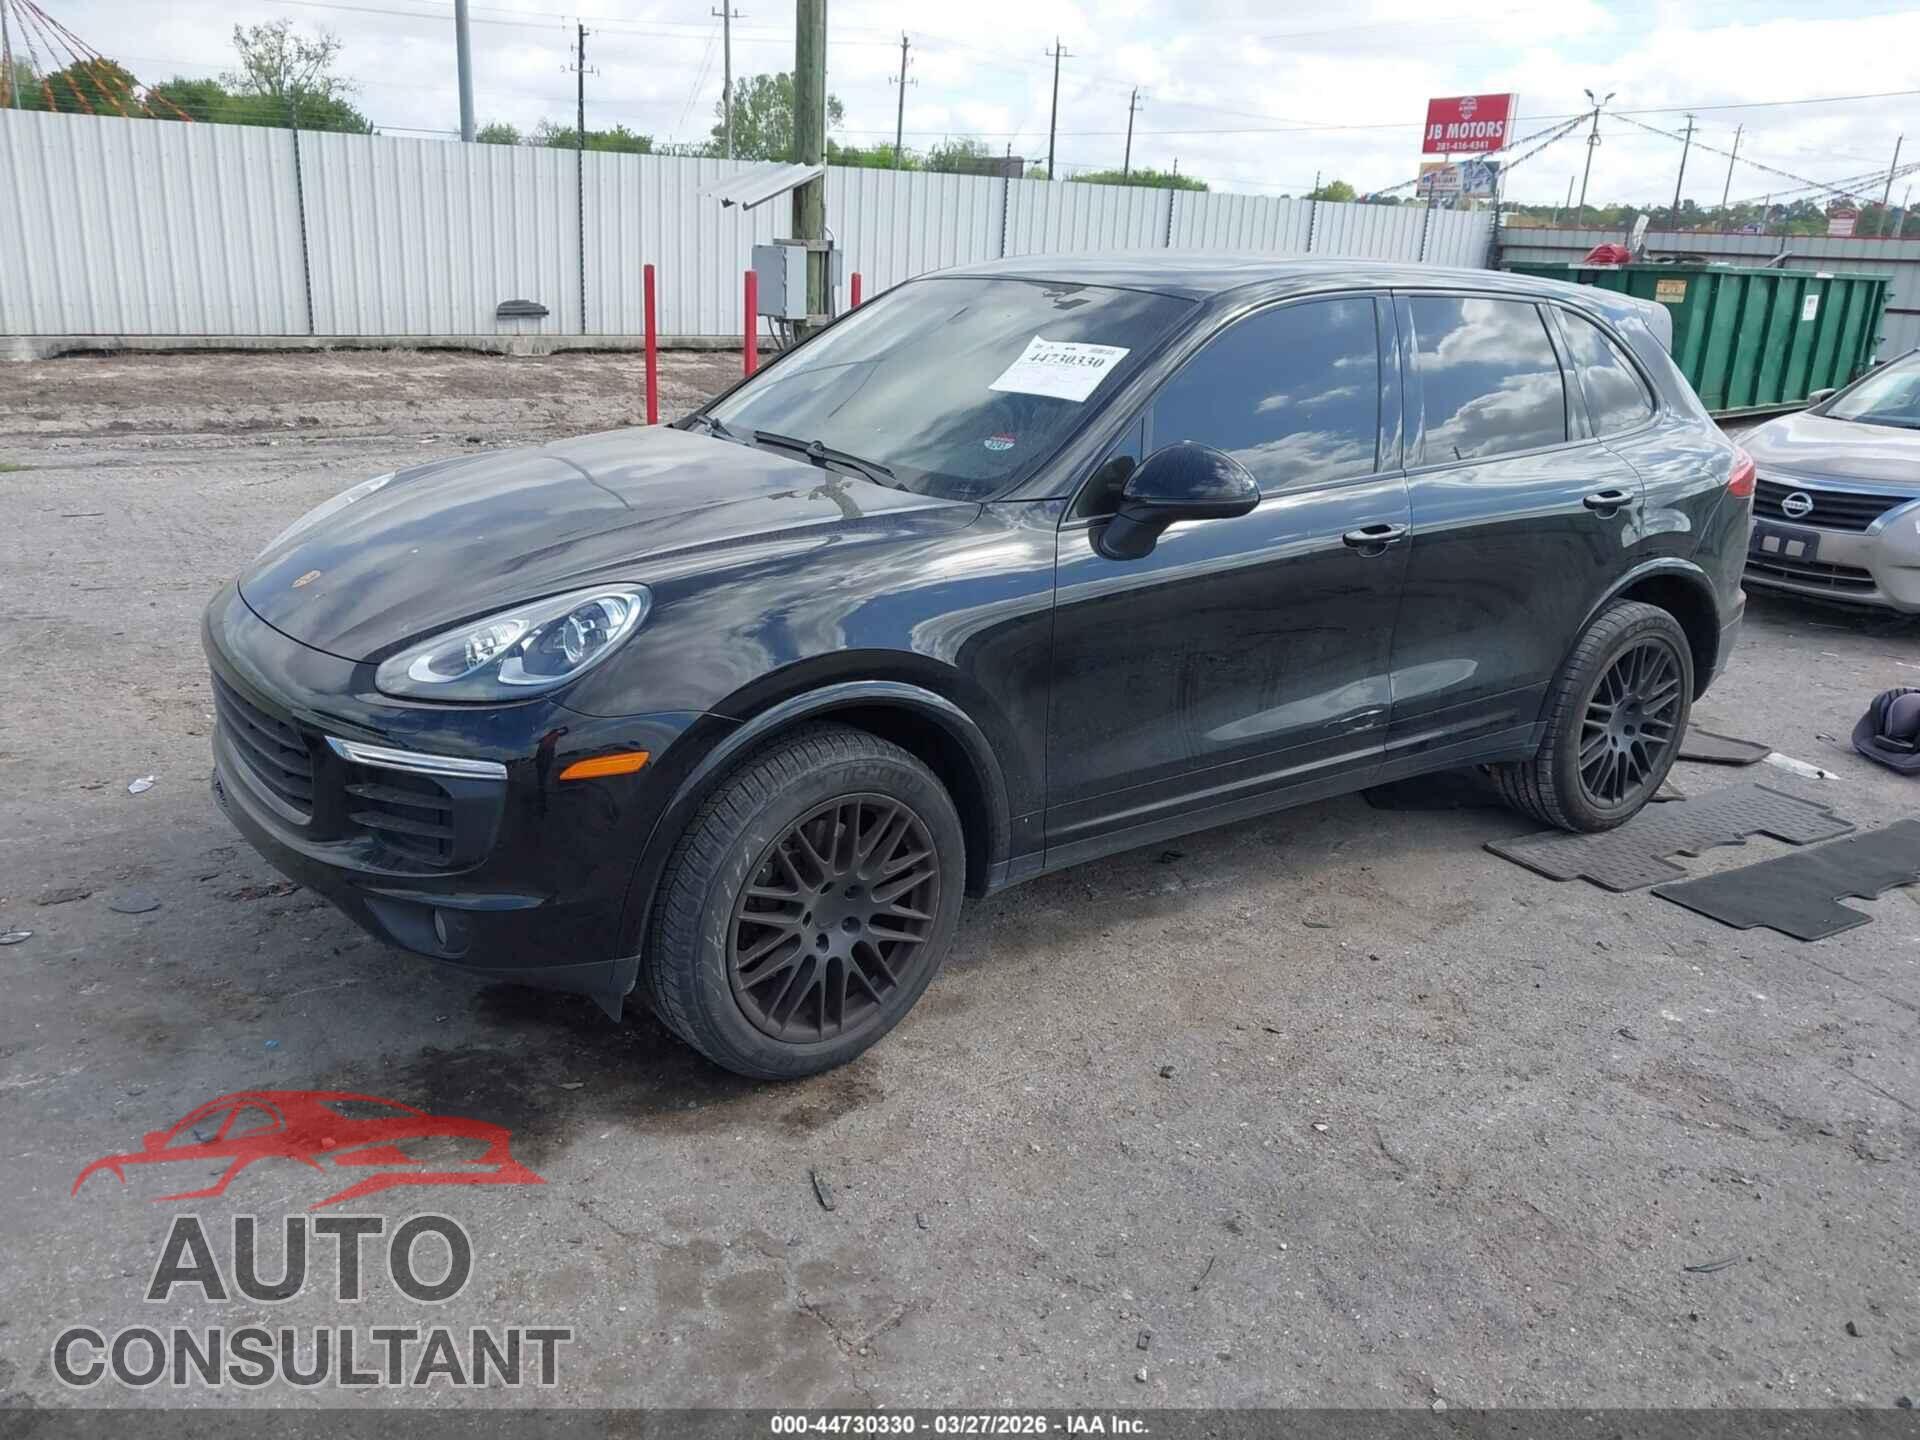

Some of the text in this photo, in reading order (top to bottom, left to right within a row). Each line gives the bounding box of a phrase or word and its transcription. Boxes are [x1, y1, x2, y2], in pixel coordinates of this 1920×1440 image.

[1426, 120, 1504, 140] JB MOTORS
[1029, 352, 1105, 368] 44730330
